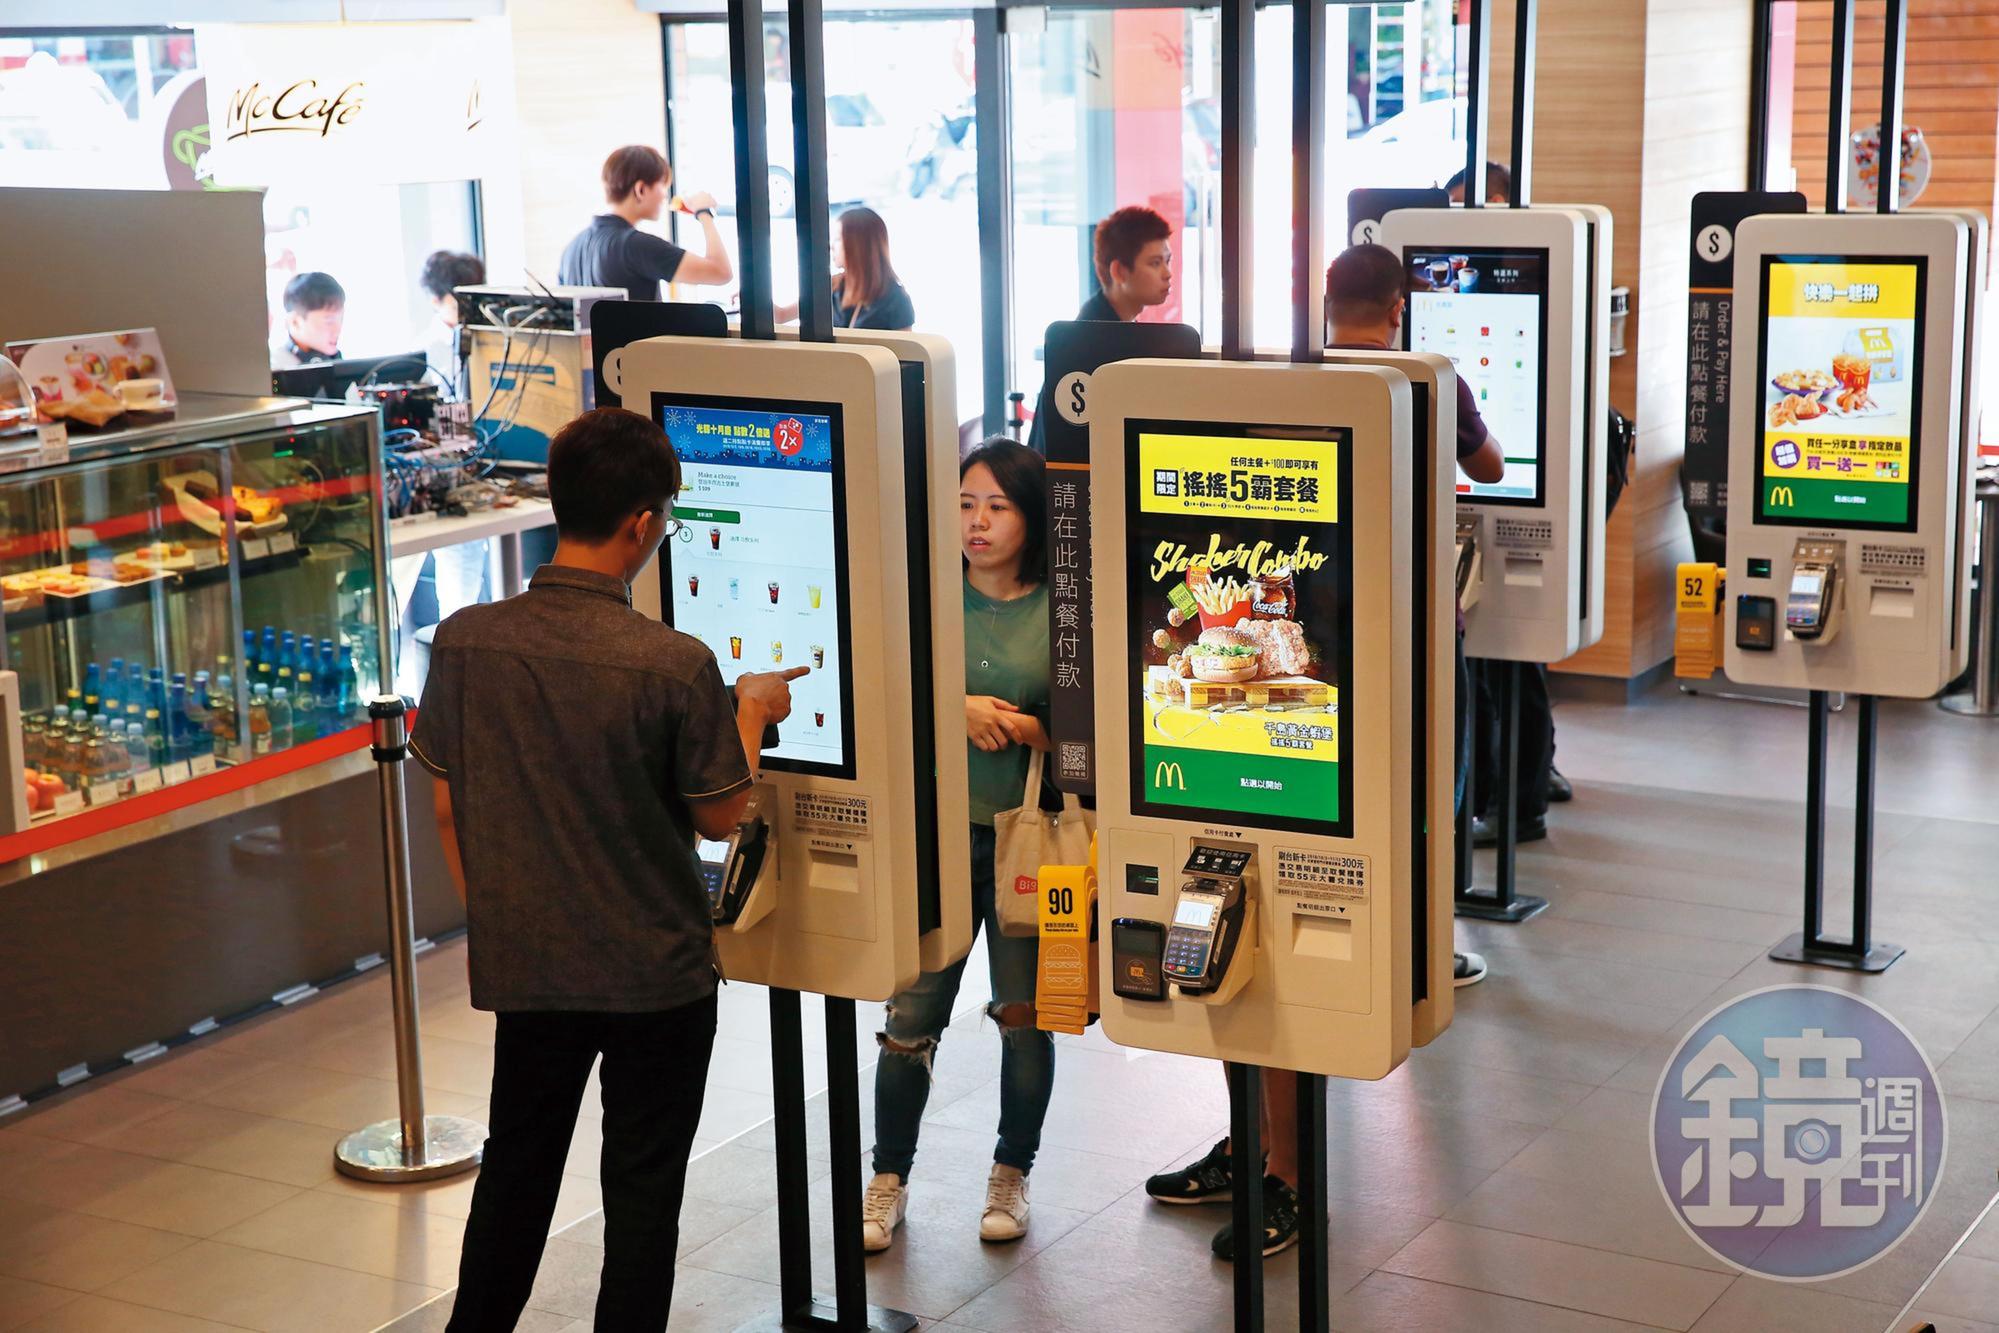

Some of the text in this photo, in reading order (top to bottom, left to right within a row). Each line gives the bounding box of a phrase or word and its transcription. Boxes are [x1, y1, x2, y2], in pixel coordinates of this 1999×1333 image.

[1717, 301, 1730, 336] Order
[1688, 301, 1710, 444] 請在此點餐付款
[1714, 350, 1729, 373] Pay
[1715, 374, 1728, 403] Here
[1807, 456, 1867, 472] 買一送一
[1155, 471, 1178, 483] 期間
[1155, 483, 1177, 495] 限定
[1052, 481, 1081, 690] 請在此點餐付款
[1684, 577, 1703, 597] 52
[1341, 857, 1365, 870] 300元
[1048, 887, 1073, 915] 90
